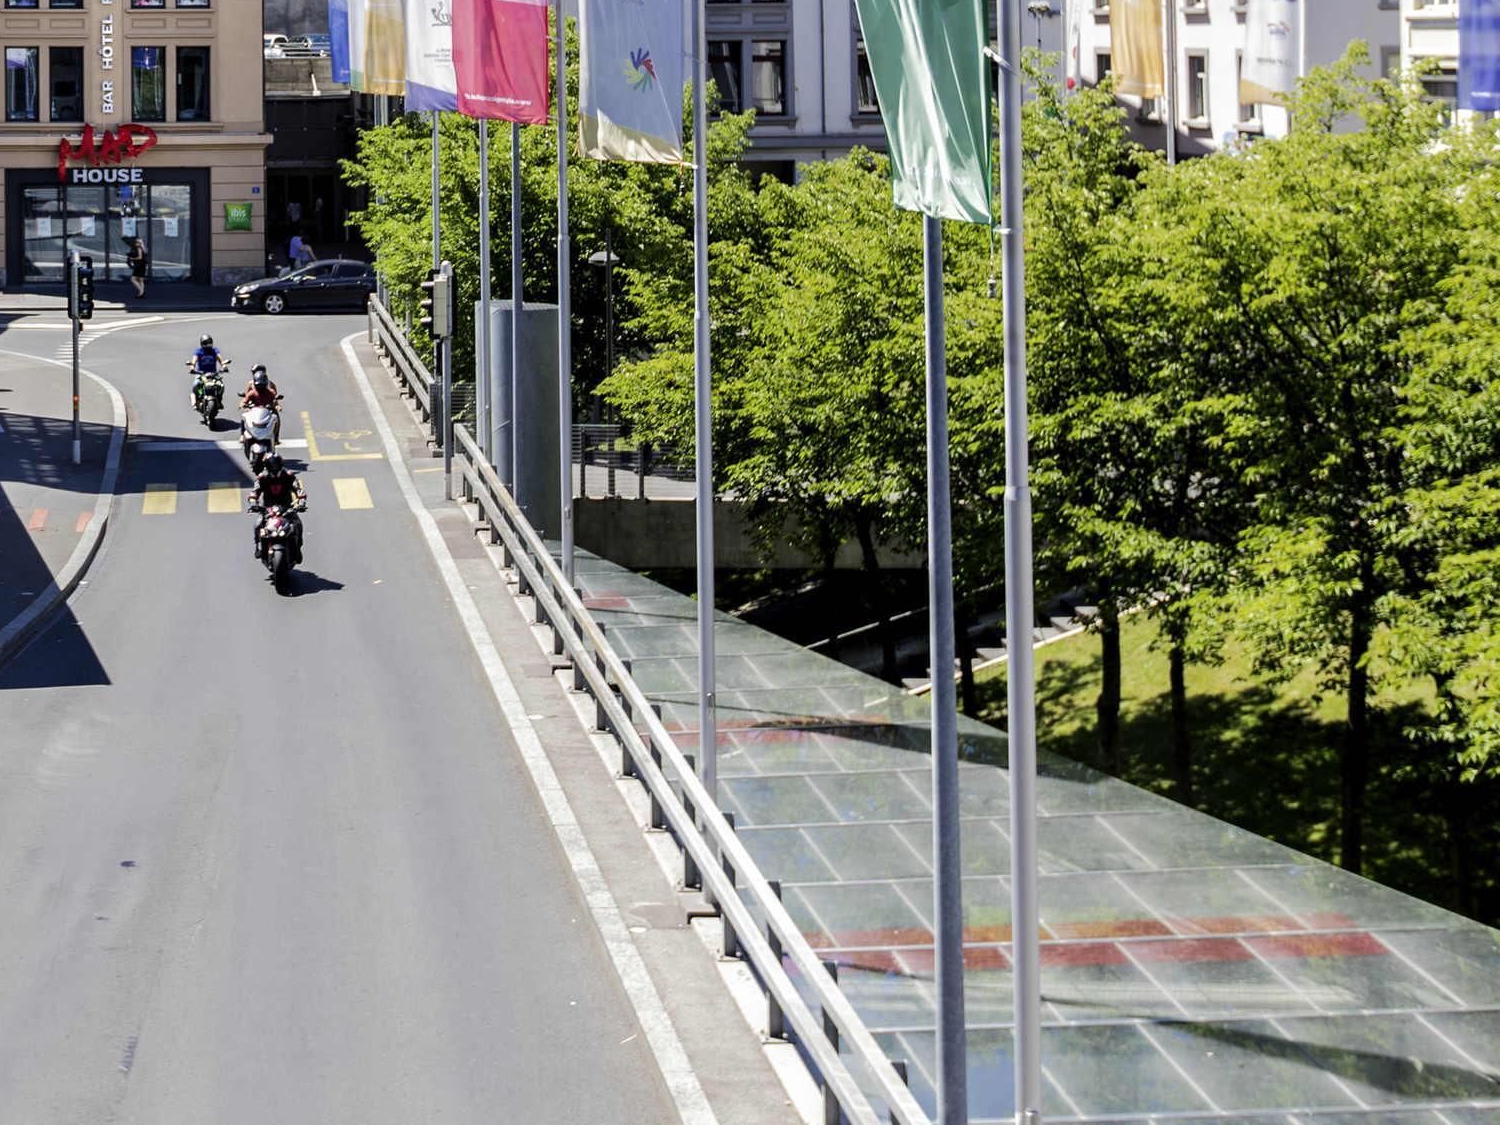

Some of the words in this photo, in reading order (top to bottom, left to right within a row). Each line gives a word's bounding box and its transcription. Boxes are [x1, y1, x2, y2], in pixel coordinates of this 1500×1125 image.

[98, 14, 113, 69] HÔTEL
[101, 81, 113, 114] BAR
[73, 169, 143, 183] HOUSE
